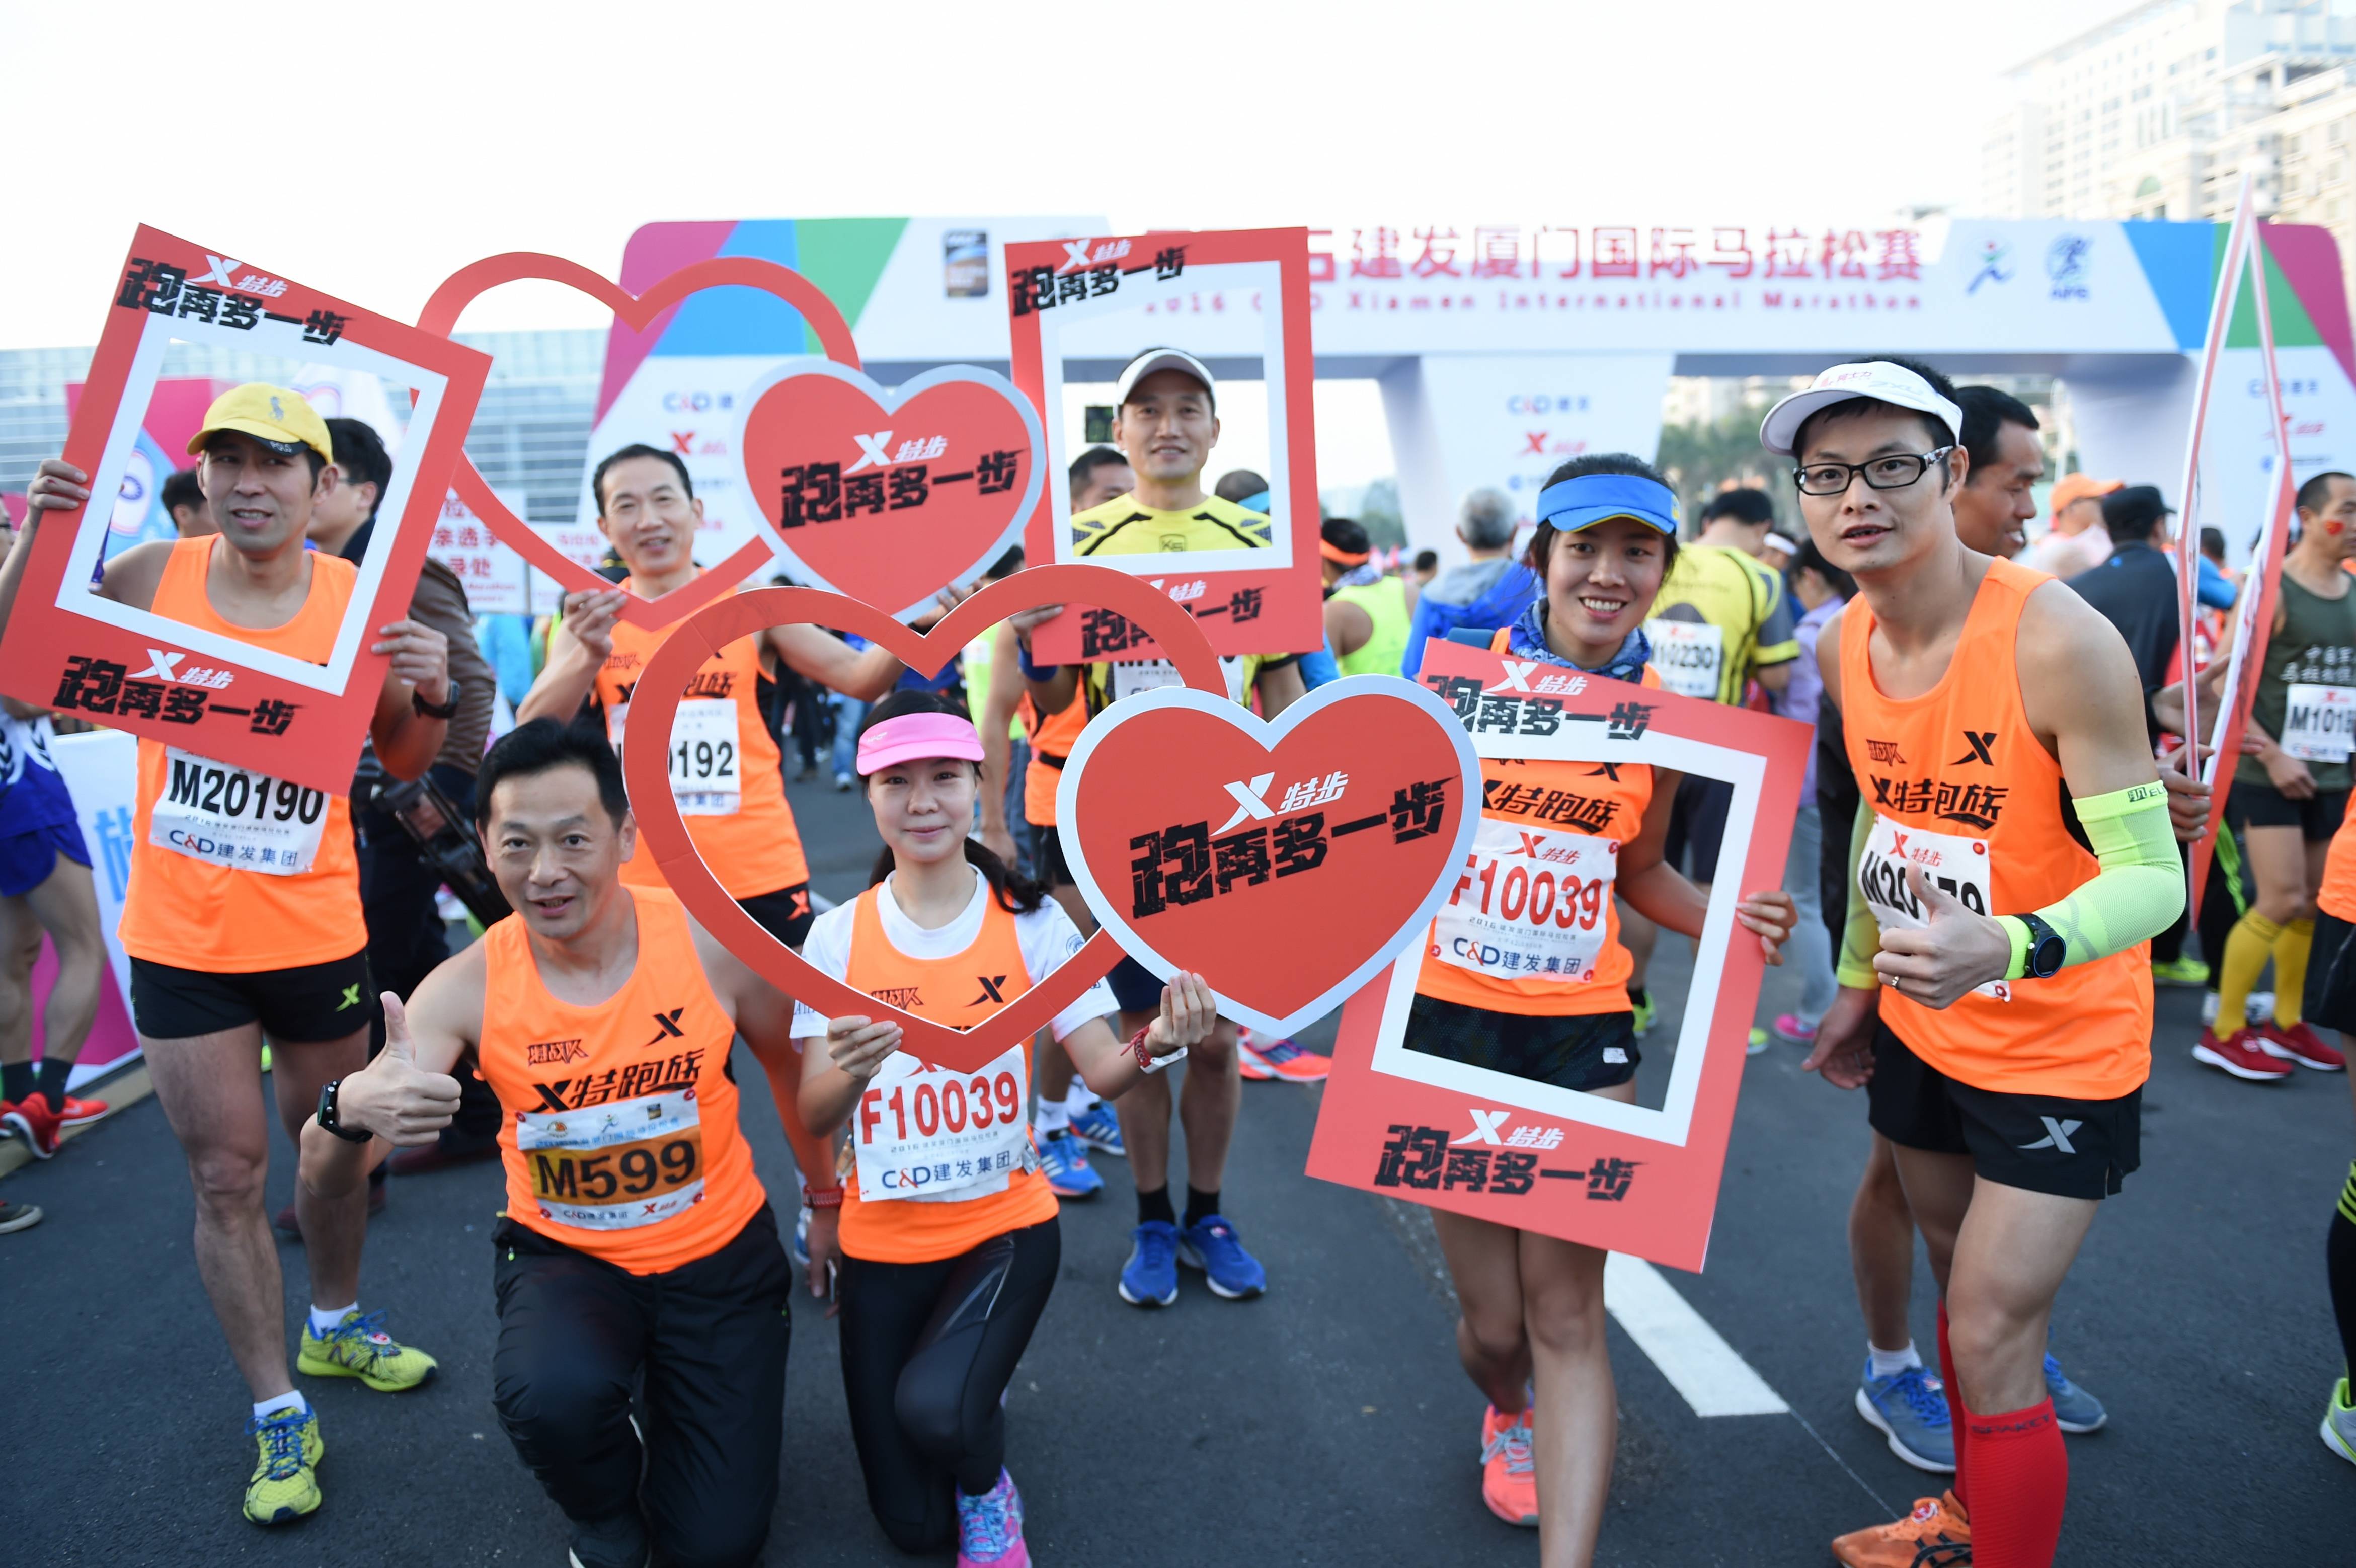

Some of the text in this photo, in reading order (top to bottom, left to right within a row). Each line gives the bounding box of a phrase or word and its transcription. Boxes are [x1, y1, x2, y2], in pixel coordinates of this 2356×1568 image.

[117, 257, 357, 346] 跑再多一步
[1011, 243, 1194, 317] 跑再多一步
[1350, 294, 1474, 309] Xiamen
[1499, 292, 1741, 309] International
[1764, 291, 1920, 309] Marathon
[781, 448, 1030, 530] 跑再多一步
[52, 655, 305, 736] 跑再多一步
[169, 759, 324, 825] M20190
[1130, 774, 1459, 920] 跑再多一步
[1448, 854, 1602, 931] F10039
[860, 1071, 1019, 1145] F10039
[535, 1139, 696, 1199] M599
[1374, 1124, 1650, 1202] 跑再多一步
